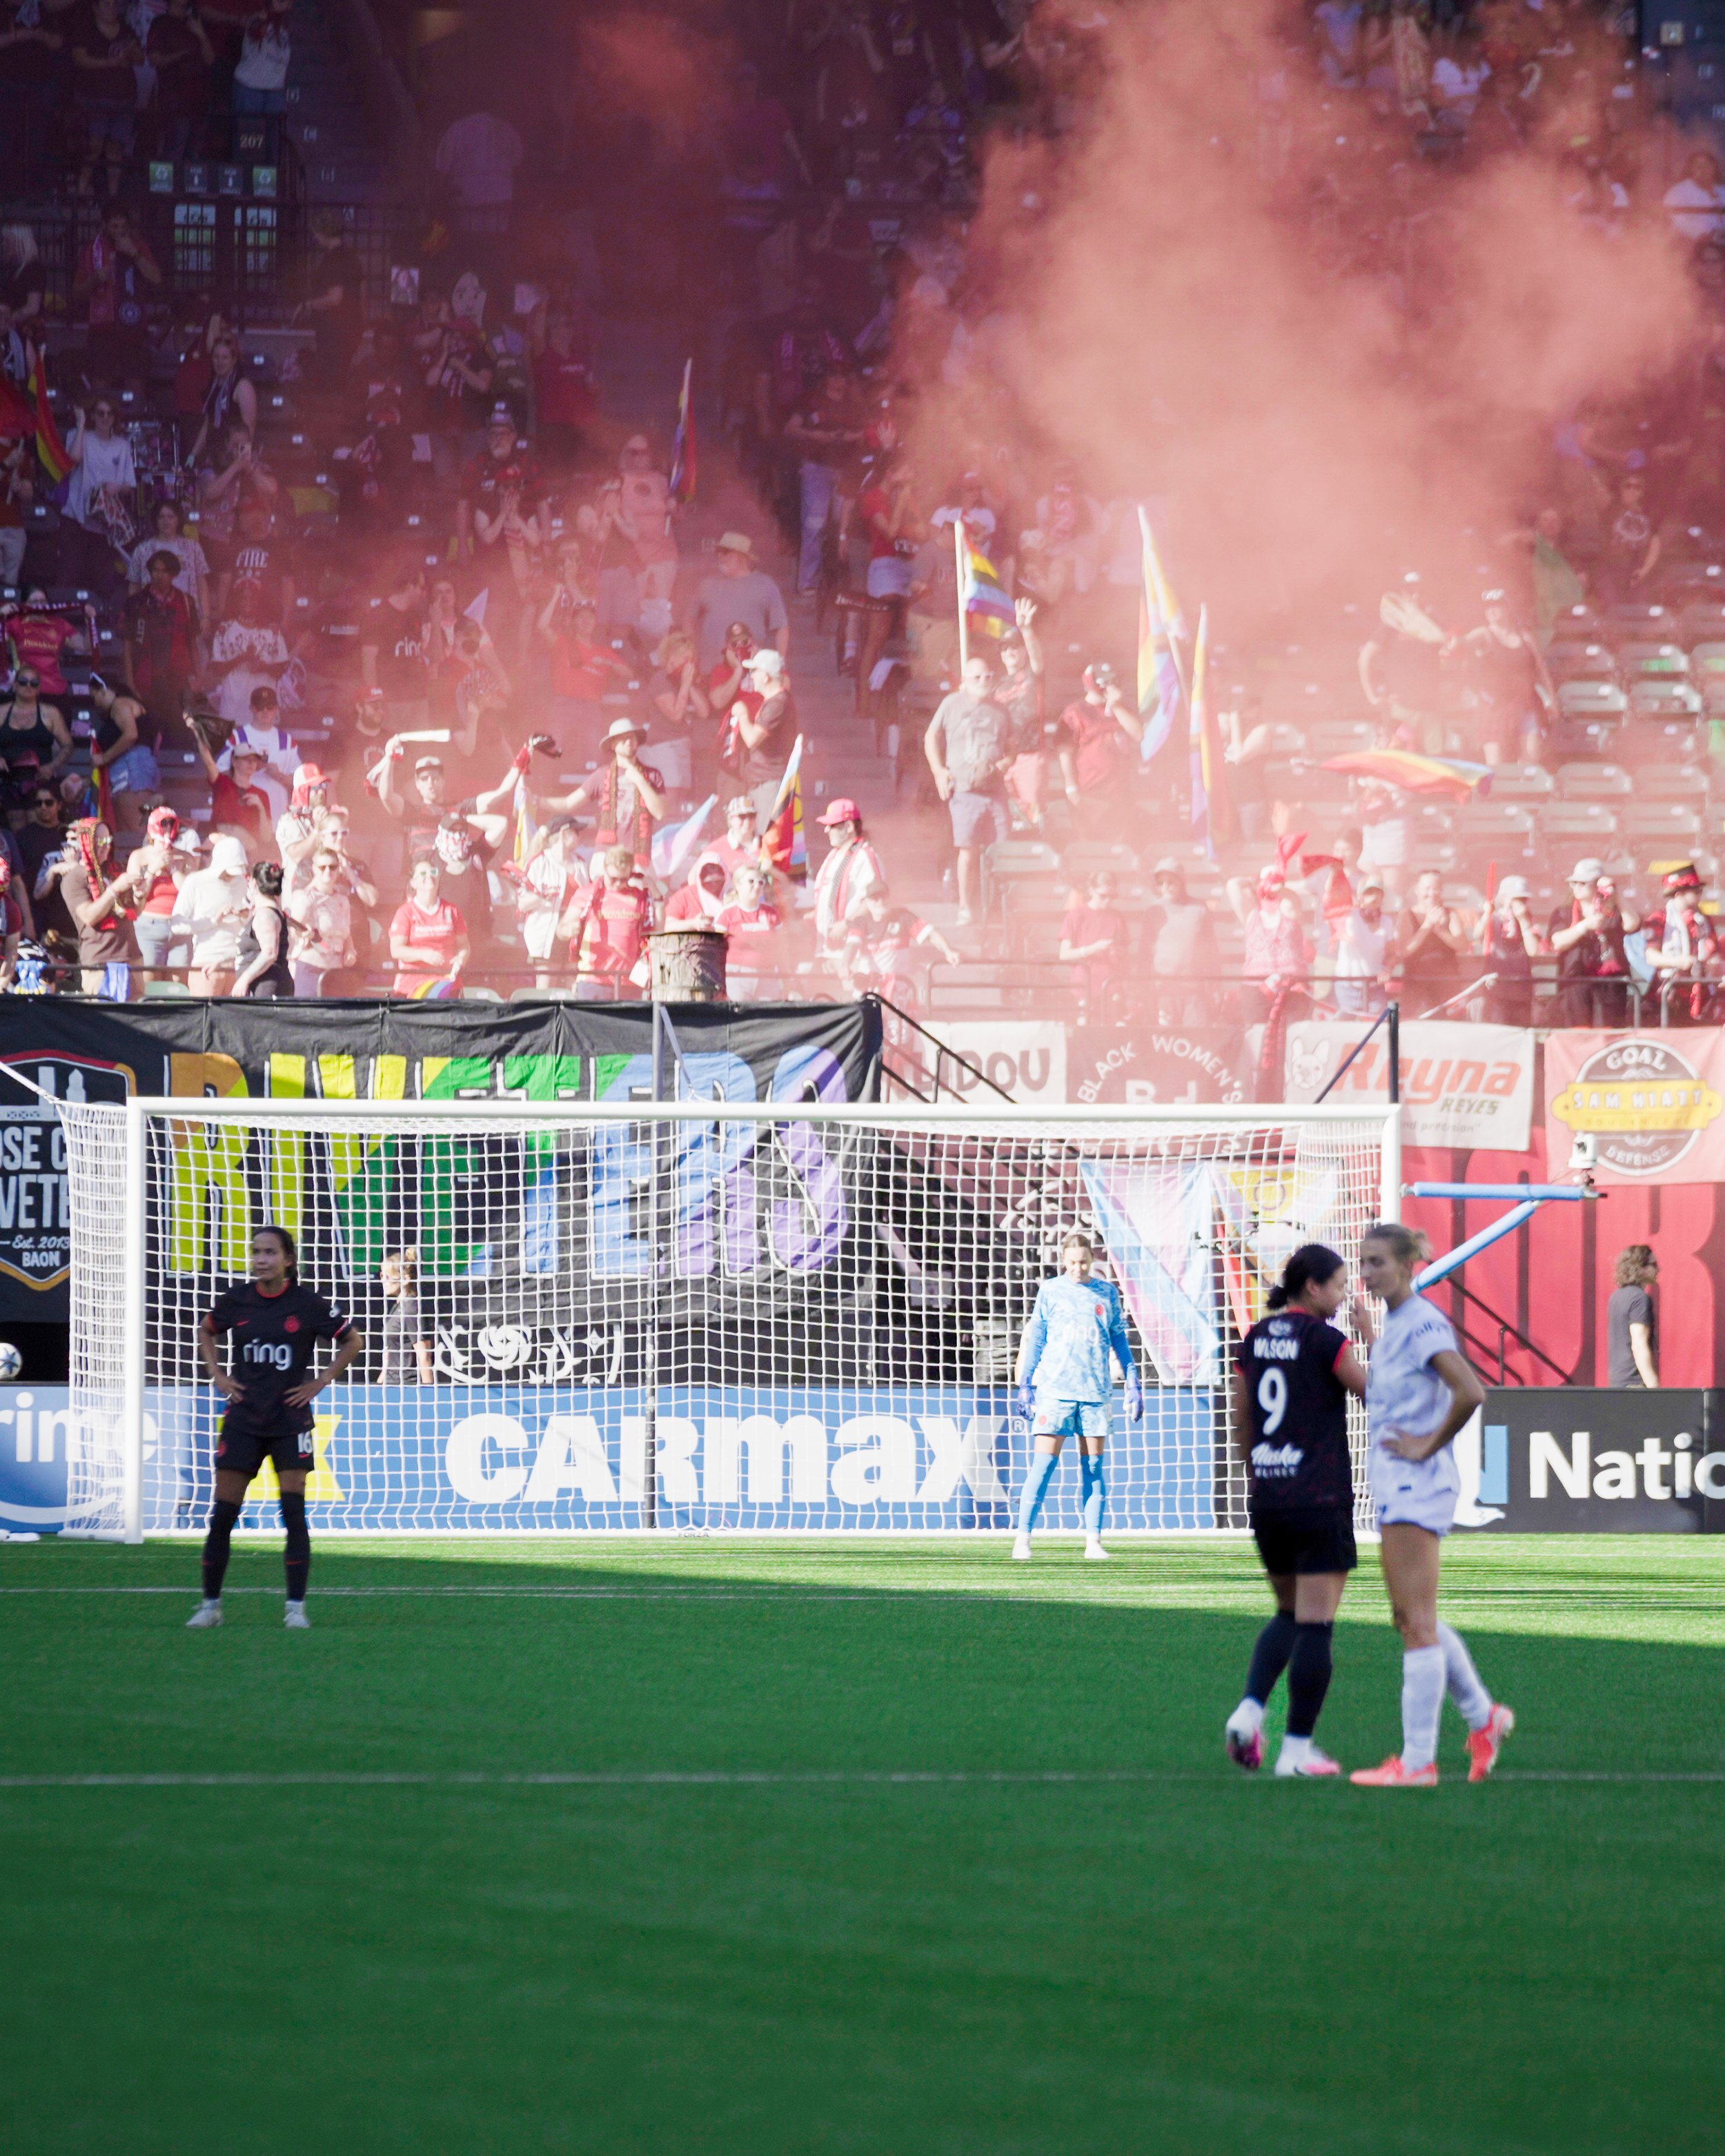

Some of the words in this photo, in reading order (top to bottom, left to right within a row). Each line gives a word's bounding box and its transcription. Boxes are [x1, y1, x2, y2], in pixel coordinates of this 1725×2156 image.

[240, 134, 264, 149] 207
[1077, 1042, 1136, 1104] BLACK
[1152, 1034, 1243, 1104] WOMEN'S
[1606, 1046, 1668, 1071] GOAL
[900, 1048, 1050, 1097] LIDOU
[1333, 1042, 1521, 1104] Reyna
[1440, 1098, 1499, 1115] REYES
[1573, 1091, 1621, 1110] SAM
[1632, 1089, 1702, 1109] HIATT
[0, 1126, 42, 1171] SE
[1606, 1145, 1672, 1166] DEFENSE
[22, 1251, 60, 1267] BAON
[243, 1338, 293, 1371] ring
[1258, 1366, 1288, 1435] 9
[297, 1432, 314, 1454] 16
